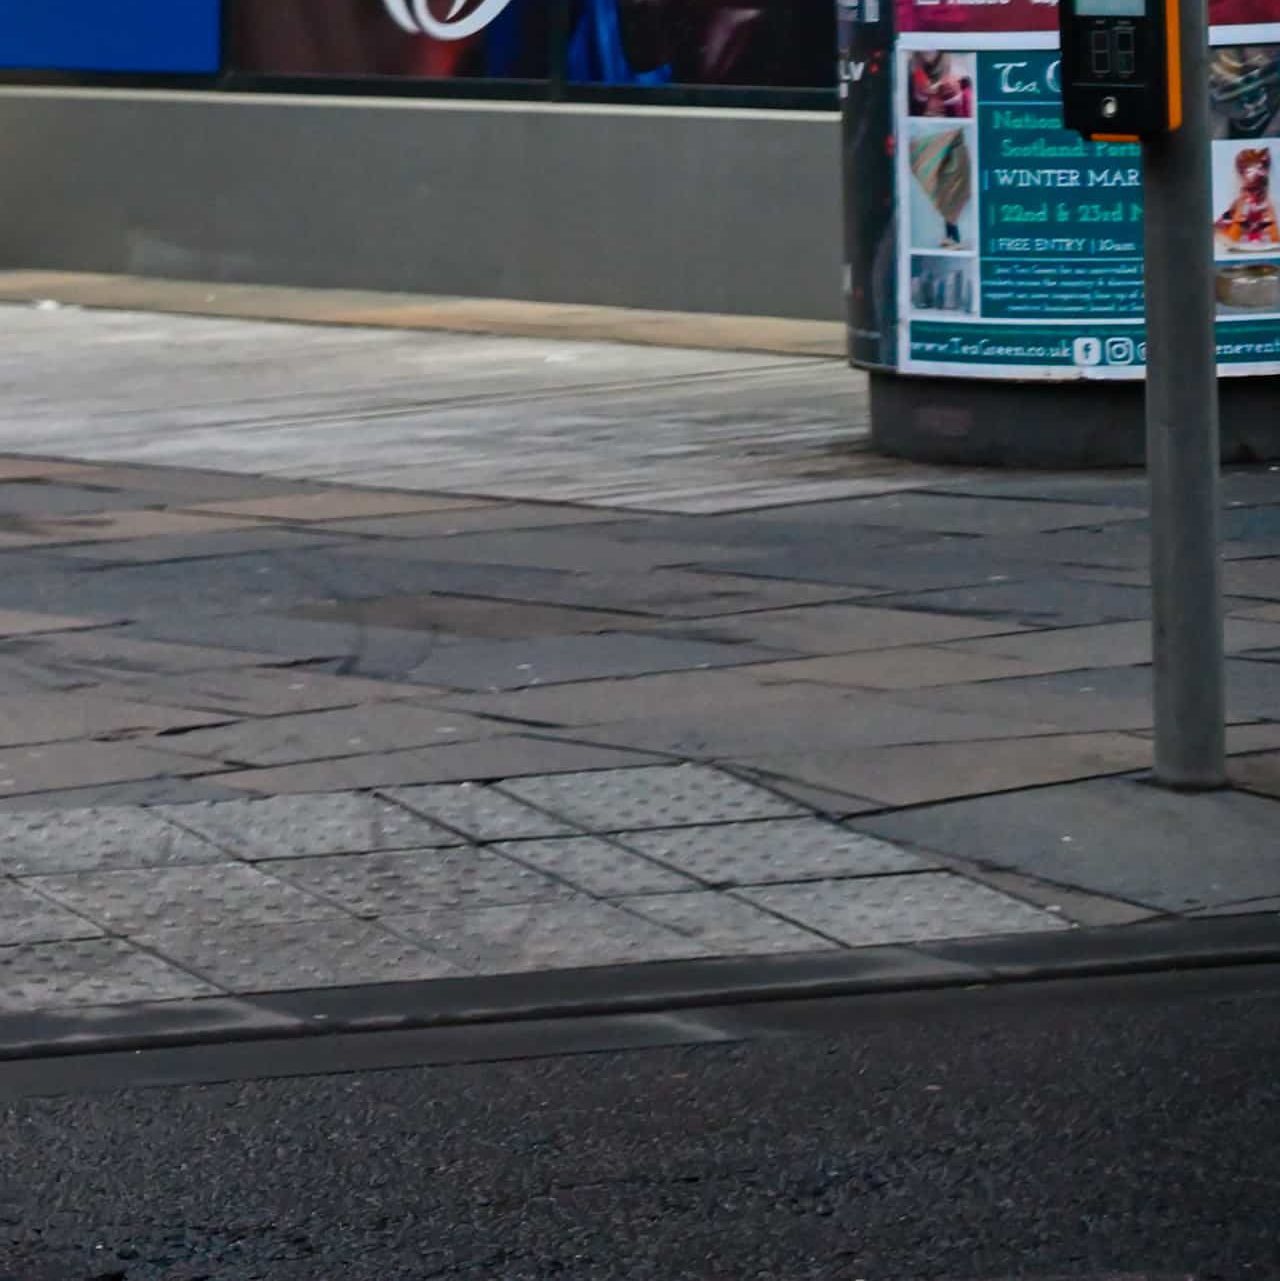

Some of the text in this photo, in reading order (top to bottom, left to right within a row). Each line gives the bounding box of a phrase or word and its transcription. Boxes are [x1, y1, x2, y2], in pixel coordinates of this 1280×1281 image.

[992, 110, 1062, 130] Nation
[994, 168, 1141, 188] WINTER MAR
[998, 238, 1031, 251] FREE
[1035, 238, 1086, 251] ENTRY
